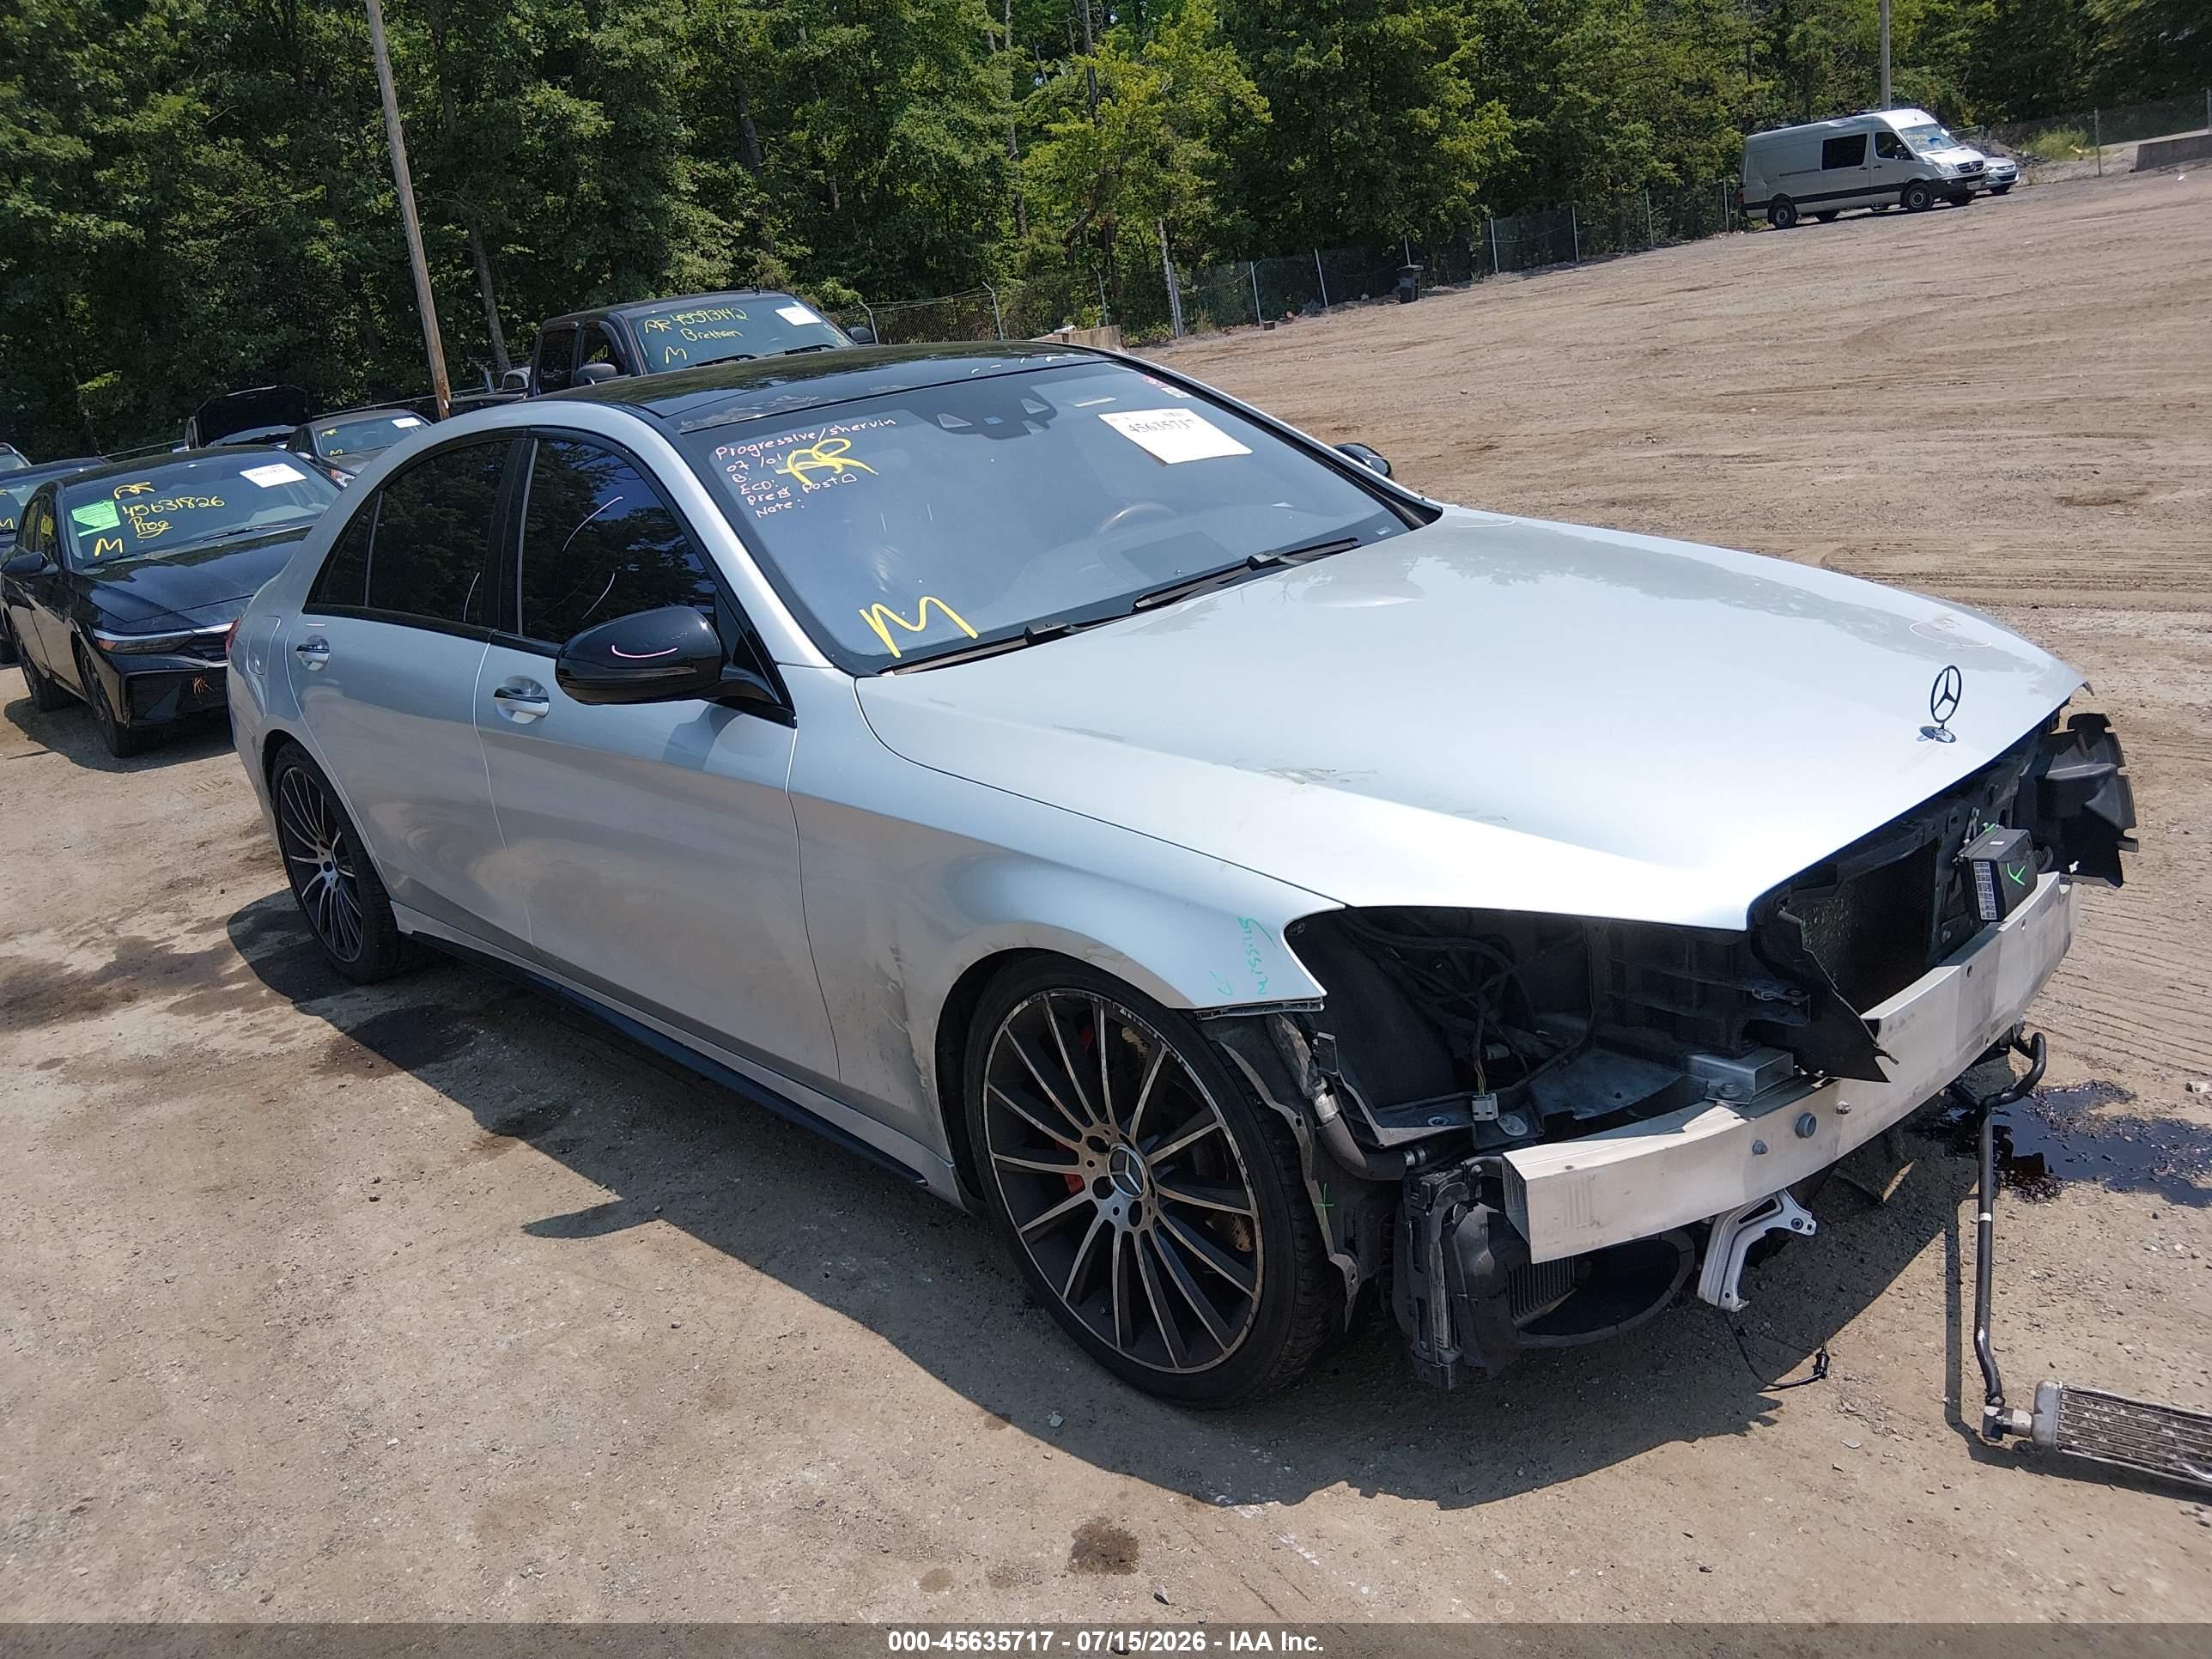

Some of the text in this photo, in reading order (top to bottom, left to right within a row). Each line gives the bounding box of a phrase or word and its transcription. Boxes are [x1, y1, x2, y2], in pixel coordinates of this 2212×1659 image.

[665, 346, 687, 363] M
[122, 495, 225, 517] 45631826
[94, 538, 124, 557] M
[859, 596, 979, 658] M
